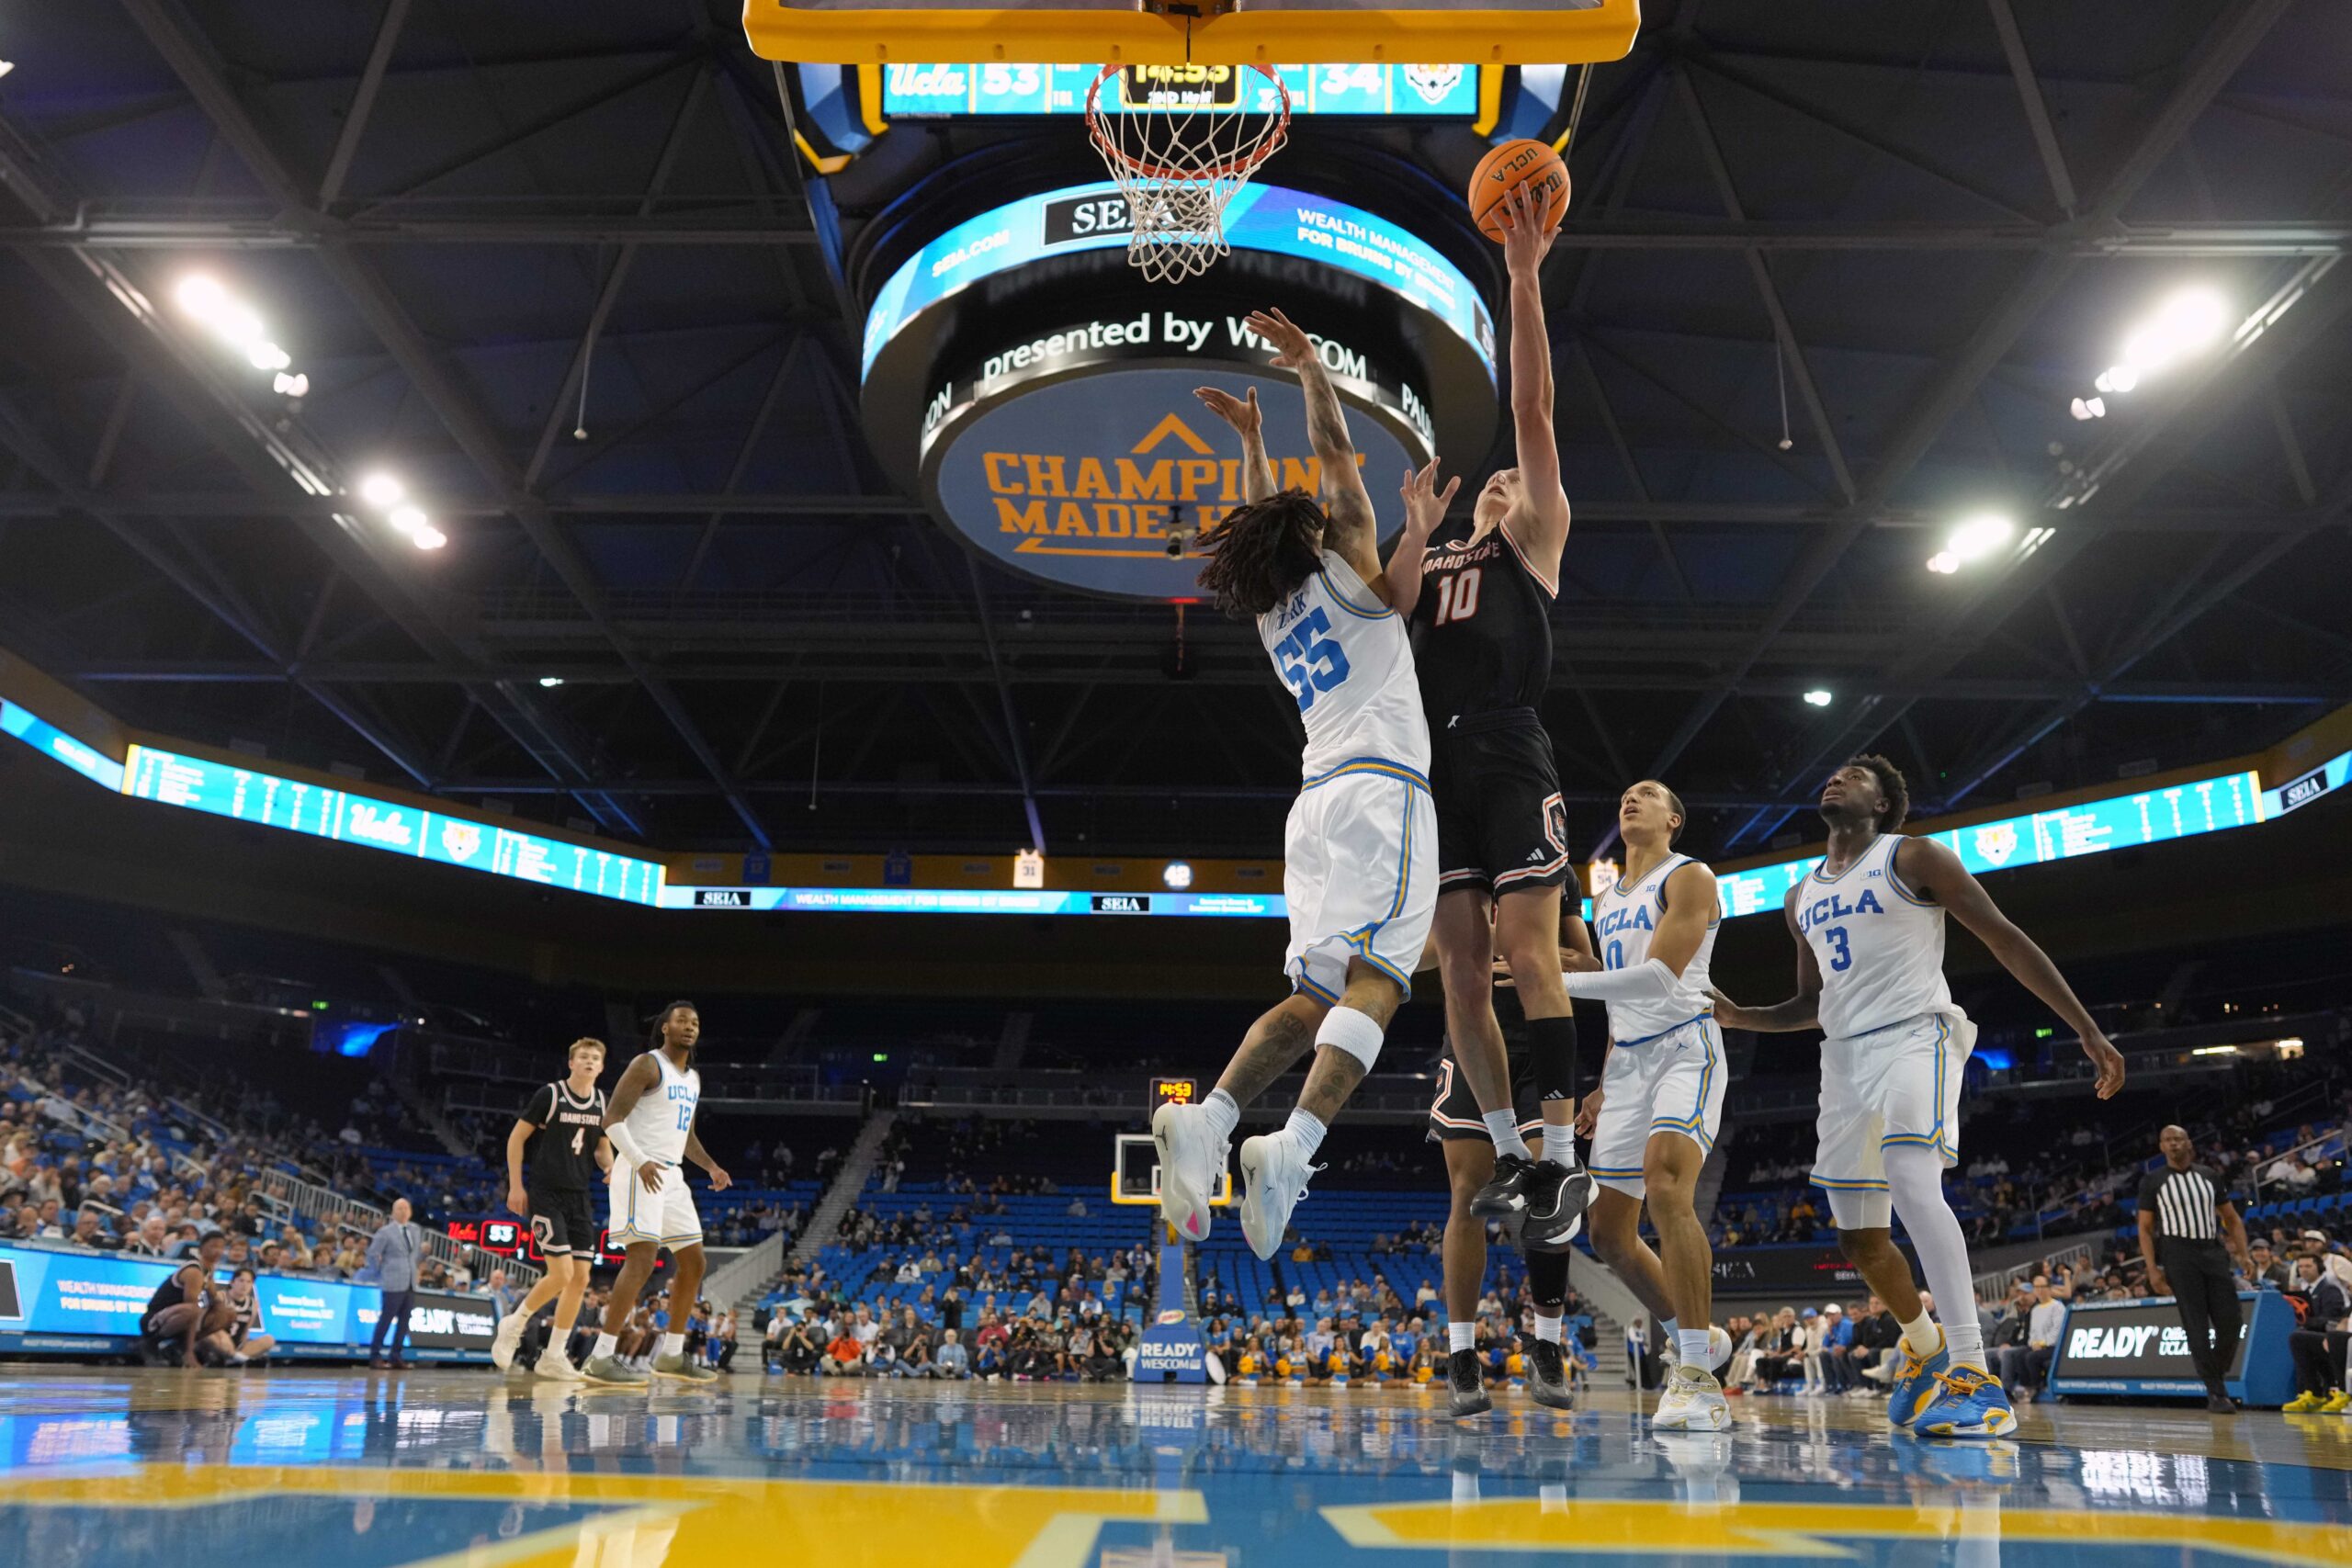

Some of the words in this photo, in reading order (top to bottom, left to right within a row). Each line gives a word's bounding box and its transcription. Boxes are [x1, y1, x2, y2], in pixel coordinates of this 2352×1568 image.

[983, 63, 1040, 96] 53
[1320, 63, 1383, 95] 34
[1491, 147, 1538, 182] UCLA
[932, 229, 1010, 277] SEIA.COM
[1297, 228, 1334, 249] FOR
[1297, 208, 1366, 241] WEALTH
[1370, 230, 1456, 292] MANAGEMENT
[983, 312, 1150, 389] presented
[1164, 311, 1214, 352] by
[992, 497, 1170, 539] MADE
[1434, 565, 1482, 626] 10
[1273, 605, 1351, 715] 55
[2287, 777, 2321, 806] SEIA
[1163, 864, 1192, 887] 42
[703, 892, 741, 906] SEIA
[1102, 897, 1140, 911] SEIA
[1799, 889, 1884, 936] UCLA
[1596, 905, 1653, 942] UCLA
[1605, 939, 1623, 971] 0
[1826, 926, 1852, 972] 3
[668, 1085, 699, 1104] UCLA
[1159, 1082, 1192, 1097] 14:53
[560, 1111, 581, 1124] IDAHO
[581, 1114, 601, 1126] STATE
[676, 1104, 691, 1132] 12
[571, 1127, 586, 1156] 4
[489, 1224, 514, 1243] 53
[1141, 1343, 1196, 1357] READY
[2068, 1325, 2150, 1359] READY
[1141, 1359, 1189, 1370] WESCOM
